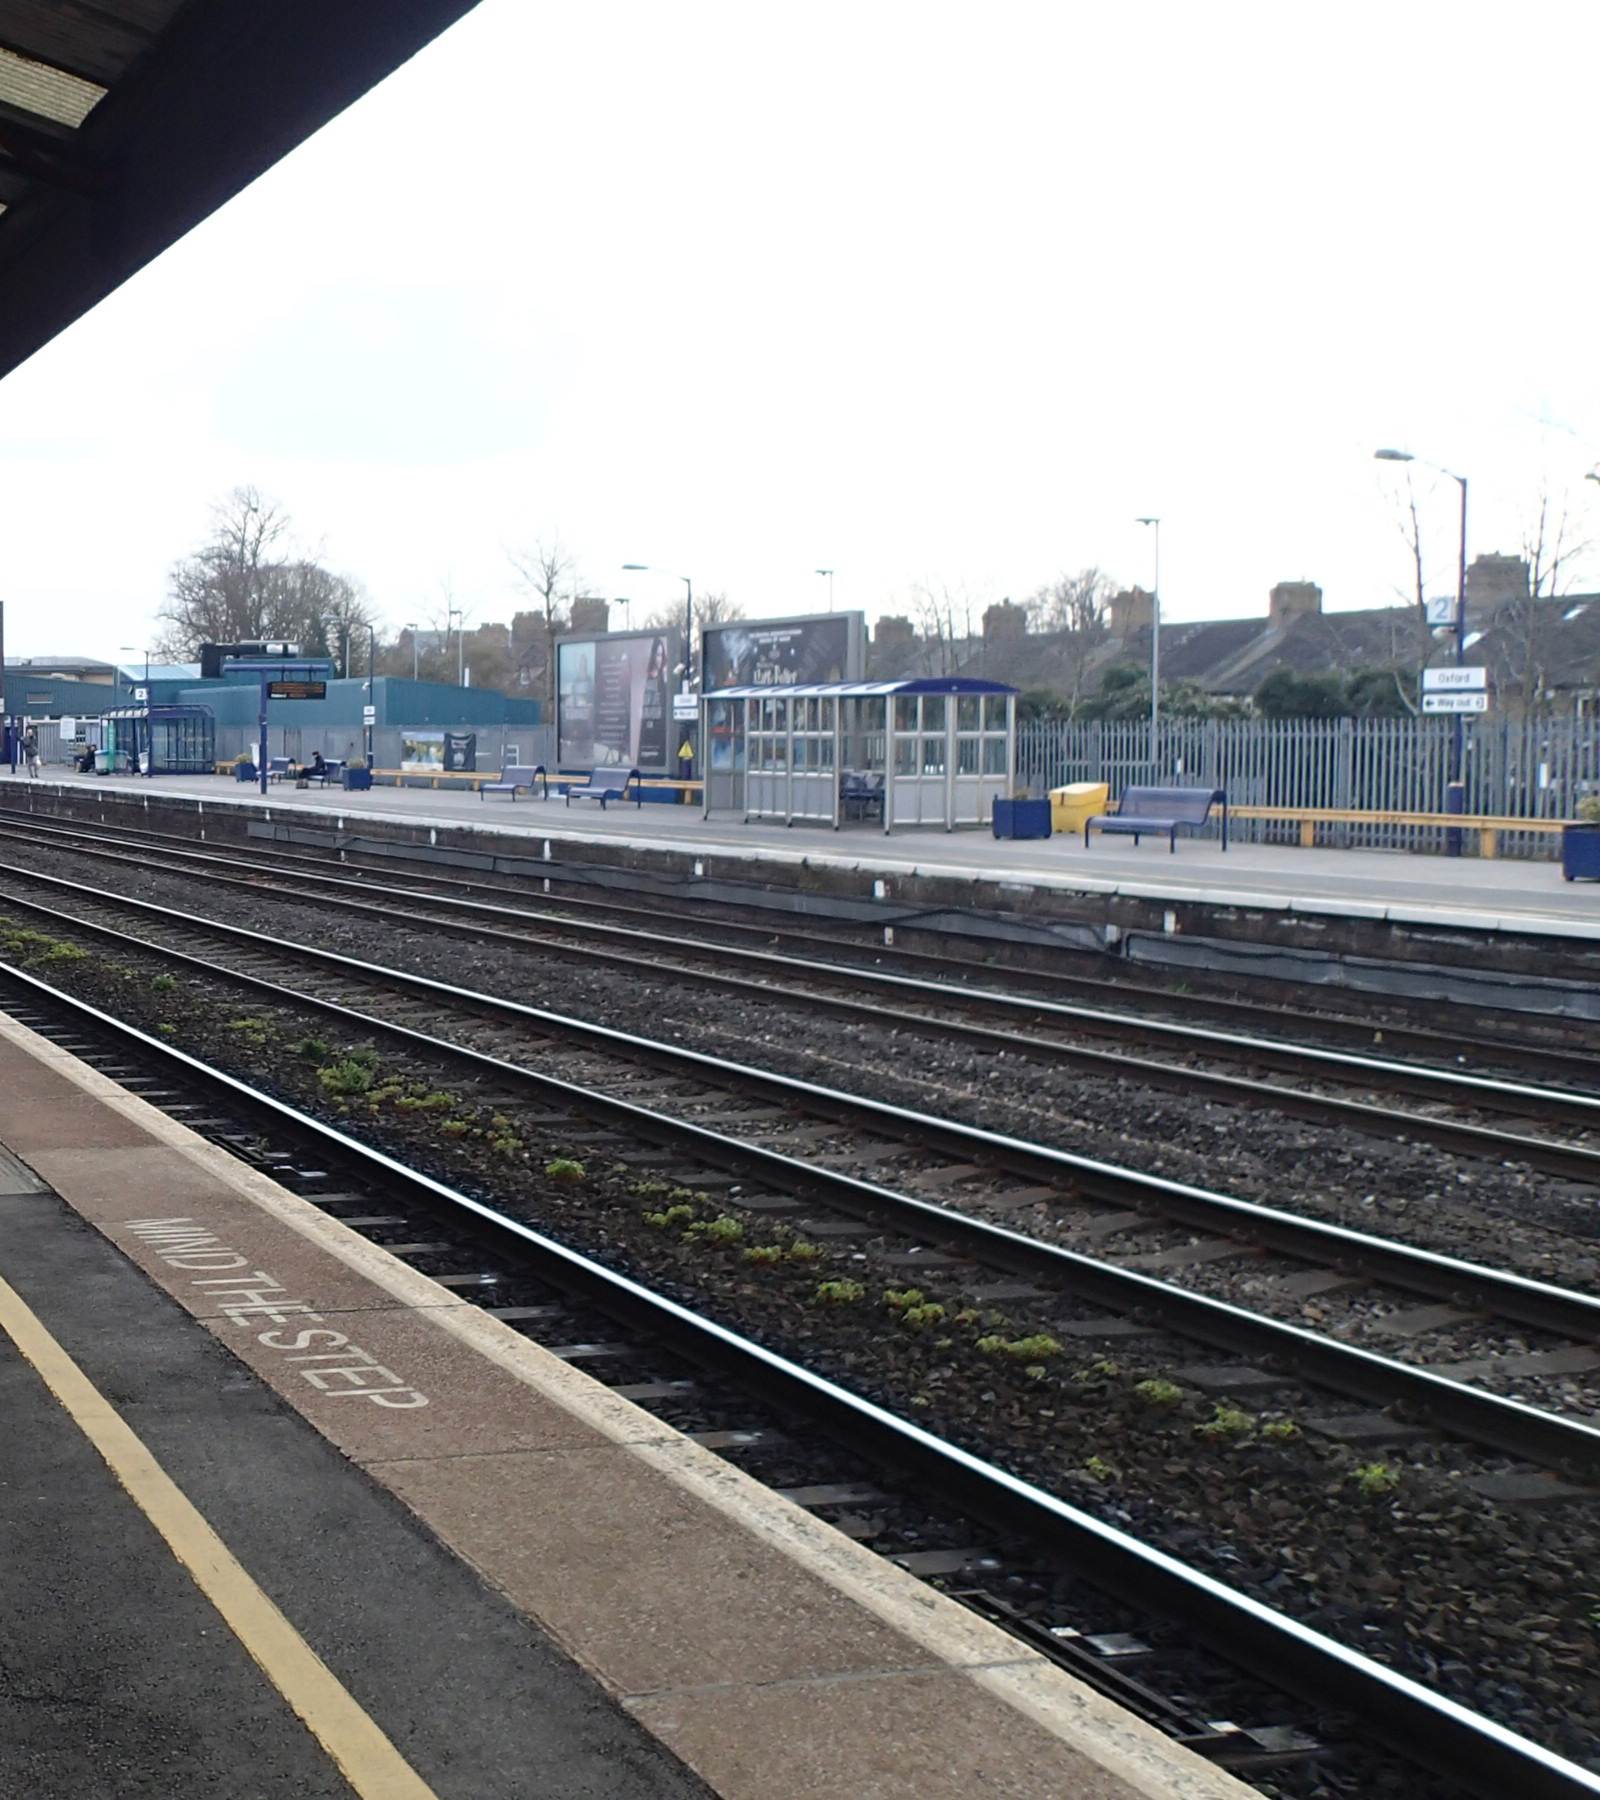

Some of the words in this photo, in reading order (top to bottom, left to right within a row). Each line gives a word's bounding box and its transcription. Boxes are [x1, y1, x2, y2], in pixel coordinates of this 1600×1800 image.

[1434, 599, 1449, 620] 2
[1438, 673, 1470, 684] Oxford
[124, 1217, 249, 1271] MIND
[191, 1271, 327, 1327] THE
[257, 1328, 430, 1410] STEP
